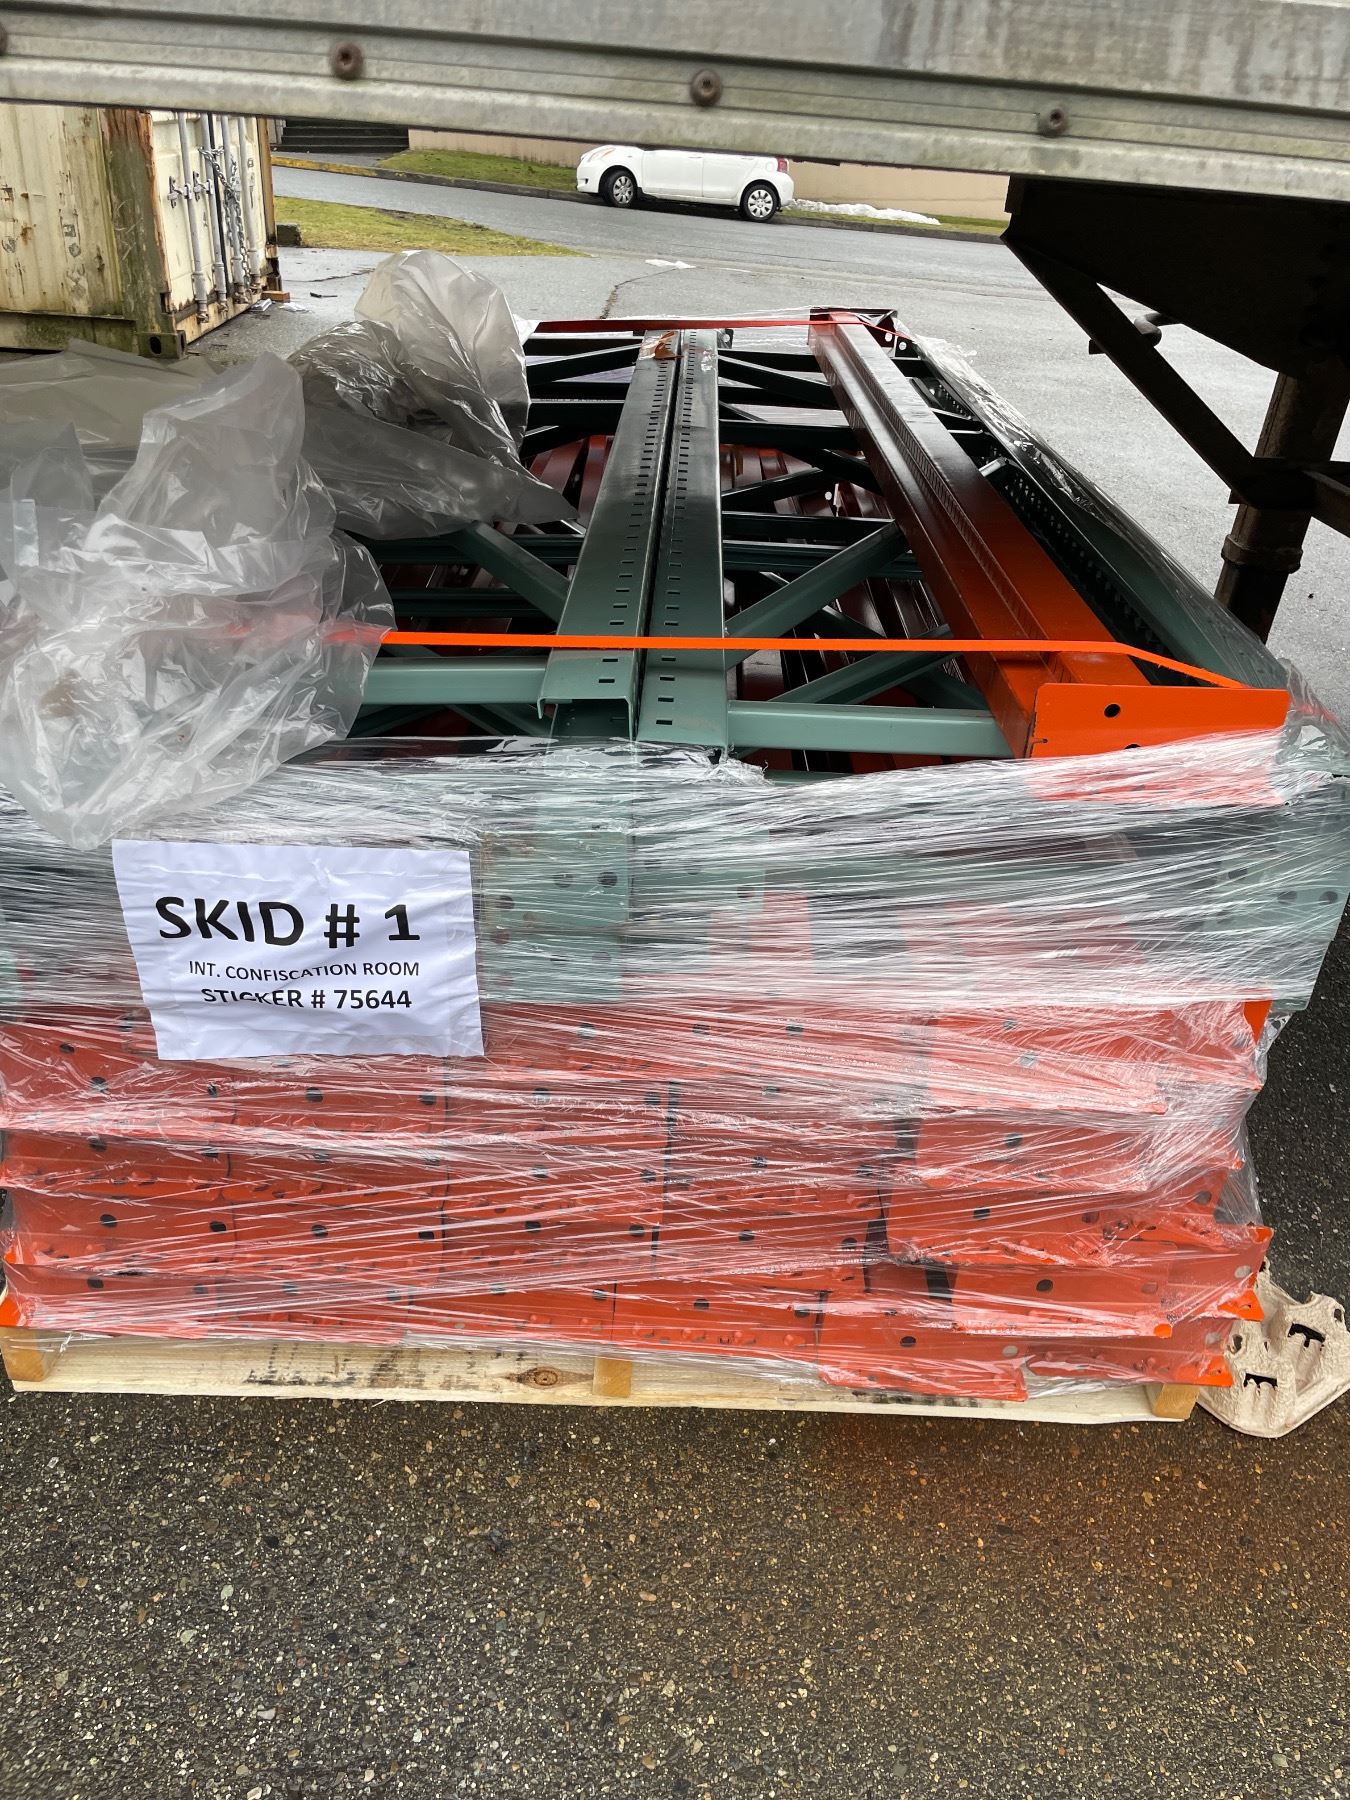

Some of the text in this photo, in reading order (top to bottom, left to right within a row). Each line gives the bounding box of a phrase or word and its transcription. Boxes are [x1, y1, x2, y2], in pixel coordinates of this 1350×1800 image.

[155, 896, 421, 949] SKID # 1
[189, 960, 419, 982] INT. CONFISCATION ROOM
[200, 988, 412, 1010] STICKER # 75644
